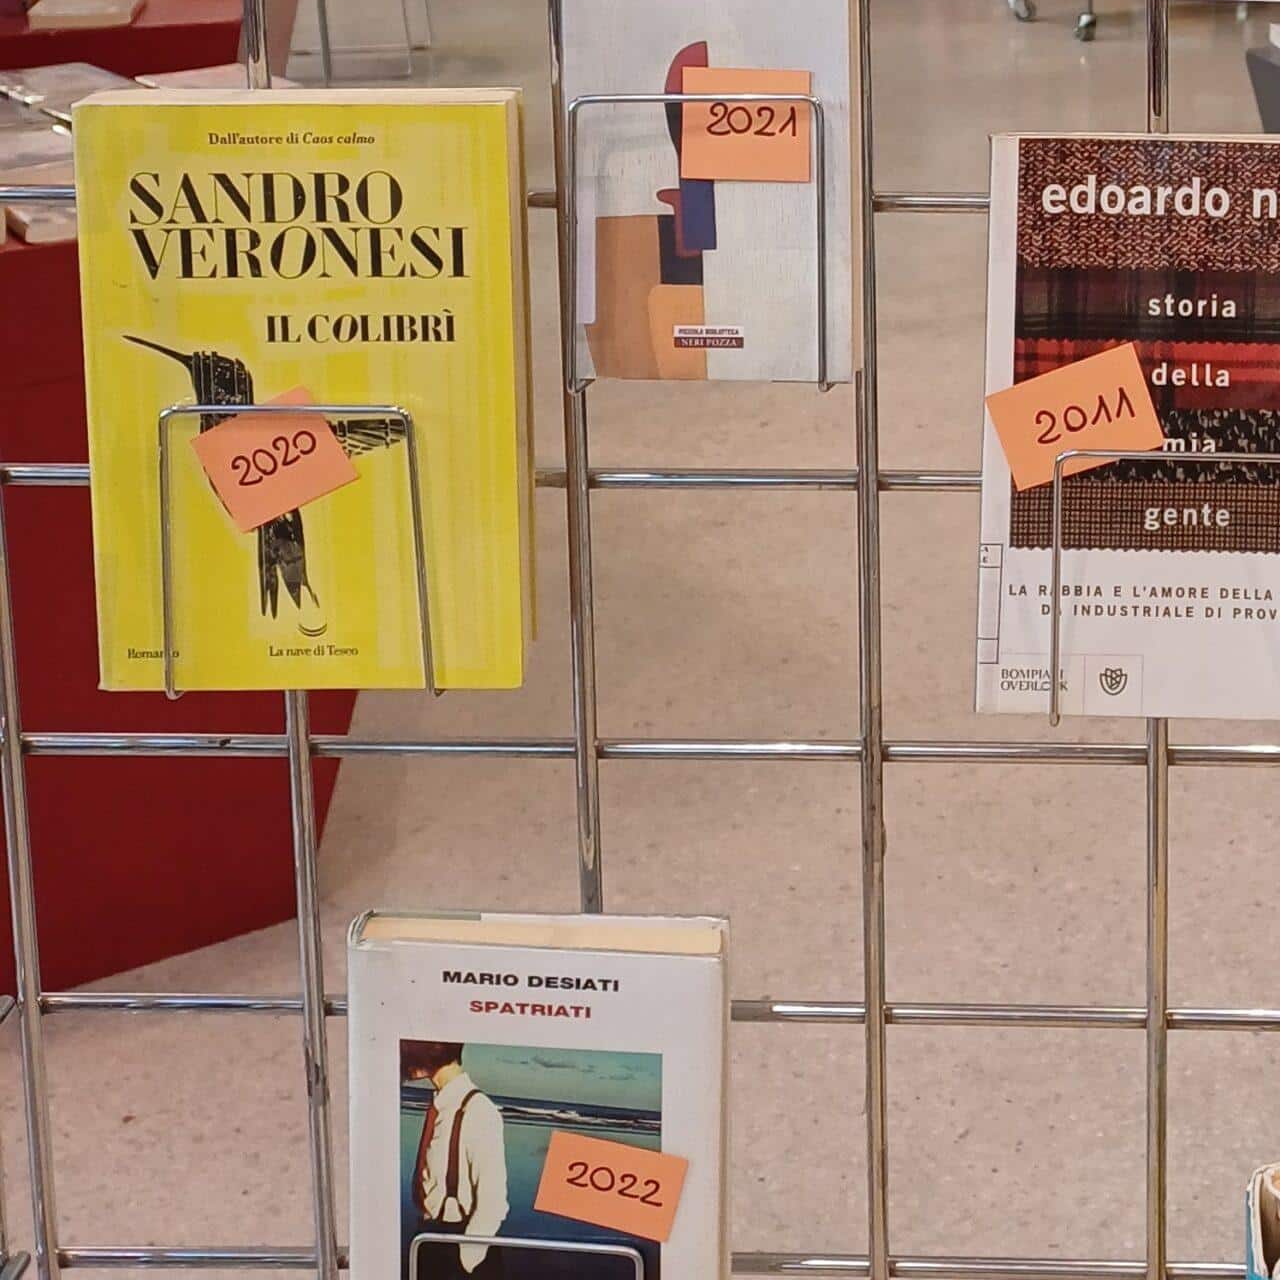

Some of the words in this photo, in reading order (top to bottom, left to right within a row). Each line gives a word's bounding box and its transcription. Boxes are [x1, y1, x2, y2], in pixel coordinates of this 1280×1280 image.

[706, 102, 798, 137] 2021
[208, 132, 283, 145] Dall'autore
[286, 132, 299, 145] di
[302, 133, 333, 145] Caos
[337, 132, 375, 145] calmo
[129, 170, 403, 225] SANDRO
[1041, 175, 1231, 218] edoardo
[128, 225, 472, 280] VERONESI
[1148, 293, 1236, 318] storia
[265, 314, 301, 343] IL
[307, 308, 456, 343] COLIBRÌ
[706, 338, 737, 346] POZZA
[1151, 362, 1231, 388] della
[1035, 387, 1136, 445] 2011
[1162, 431, 1217, 454] mia
[231, 430, 317, 486] 2020
[1143, 503, 1231, 531] gente
[1008, 584, 1028, 597] LA
[1038, 584, 1103, 598] RBBIA
[1113, 585, 1122, 597] E
[1132, 585, 1210, 600] L'AMORE
[1219, 587, 1273, 602] DELLA
[1041, 603, 1062, 616] D
[1073, 604, 1195, 618] INDUSTRIALE
[1204, 607, 1223, 619] DI
[269, 645, 284, 657] La
[285, 647, 312, 657] nave
[313, 645, 325, 656] di
[326, 645, 359, 656] Teseo
[1001, 669, 1065, 680] BOMPIAI
[442, 970, 520, 987] MARIO
[527, 975, 620, 992] DESIATI
[469, 1000, 592, 1019] SPATRIATI
[566, 1161, 664, 1208] 2022
